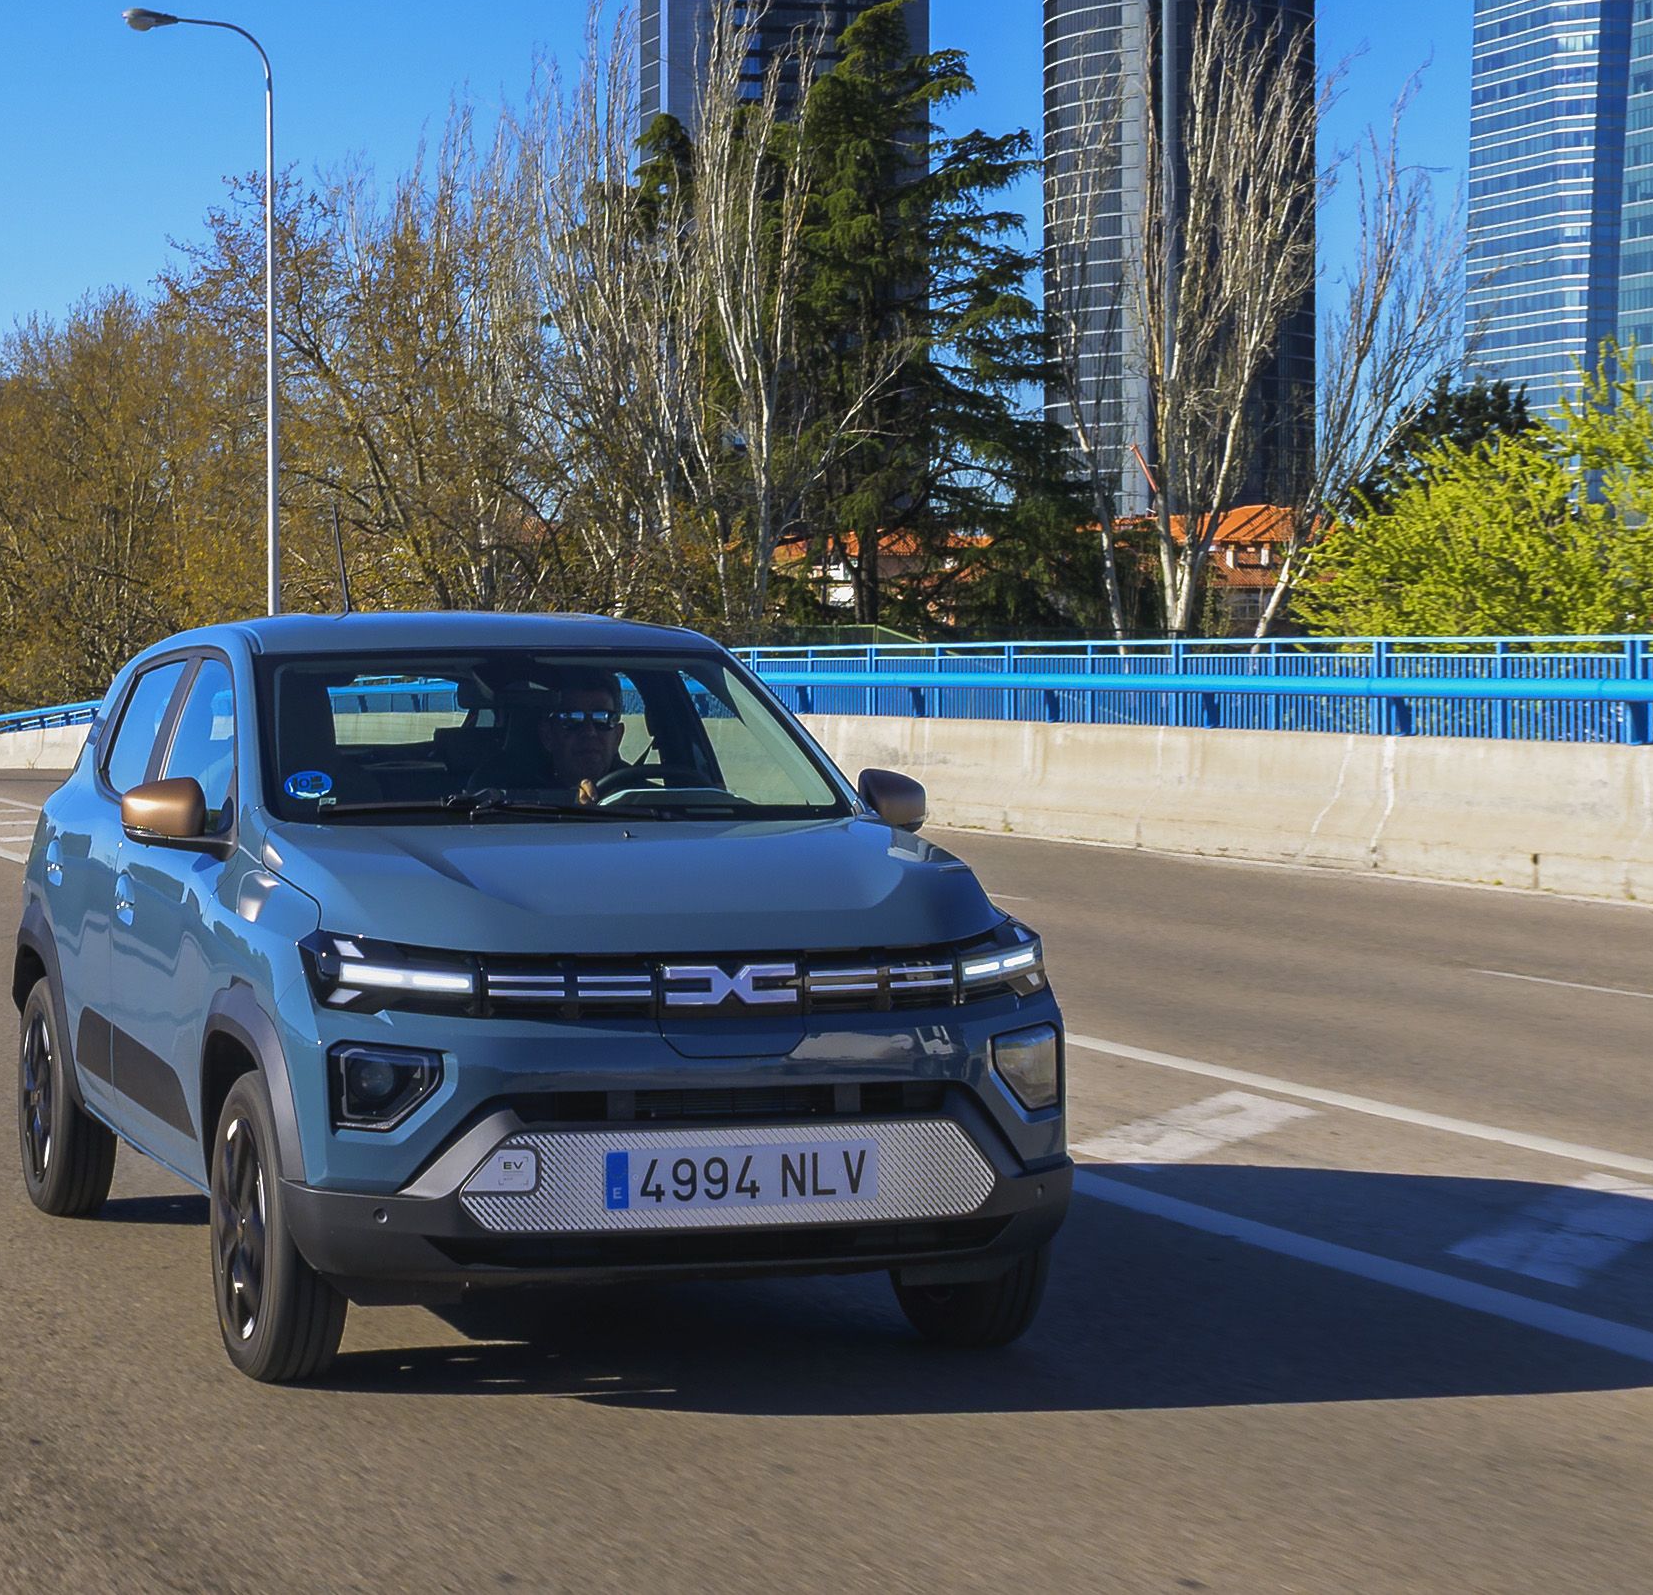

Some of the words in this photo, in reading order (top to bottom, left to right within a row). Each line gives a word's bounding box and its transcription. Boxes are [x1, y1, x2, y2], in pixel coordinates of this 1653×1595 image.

[503, 1161, 523, 1170] EV
[640, 1155, 760, 1202] 4994
[781, 1149, 866, 1198] NLV
[612, 1186, 623, 1200] E
